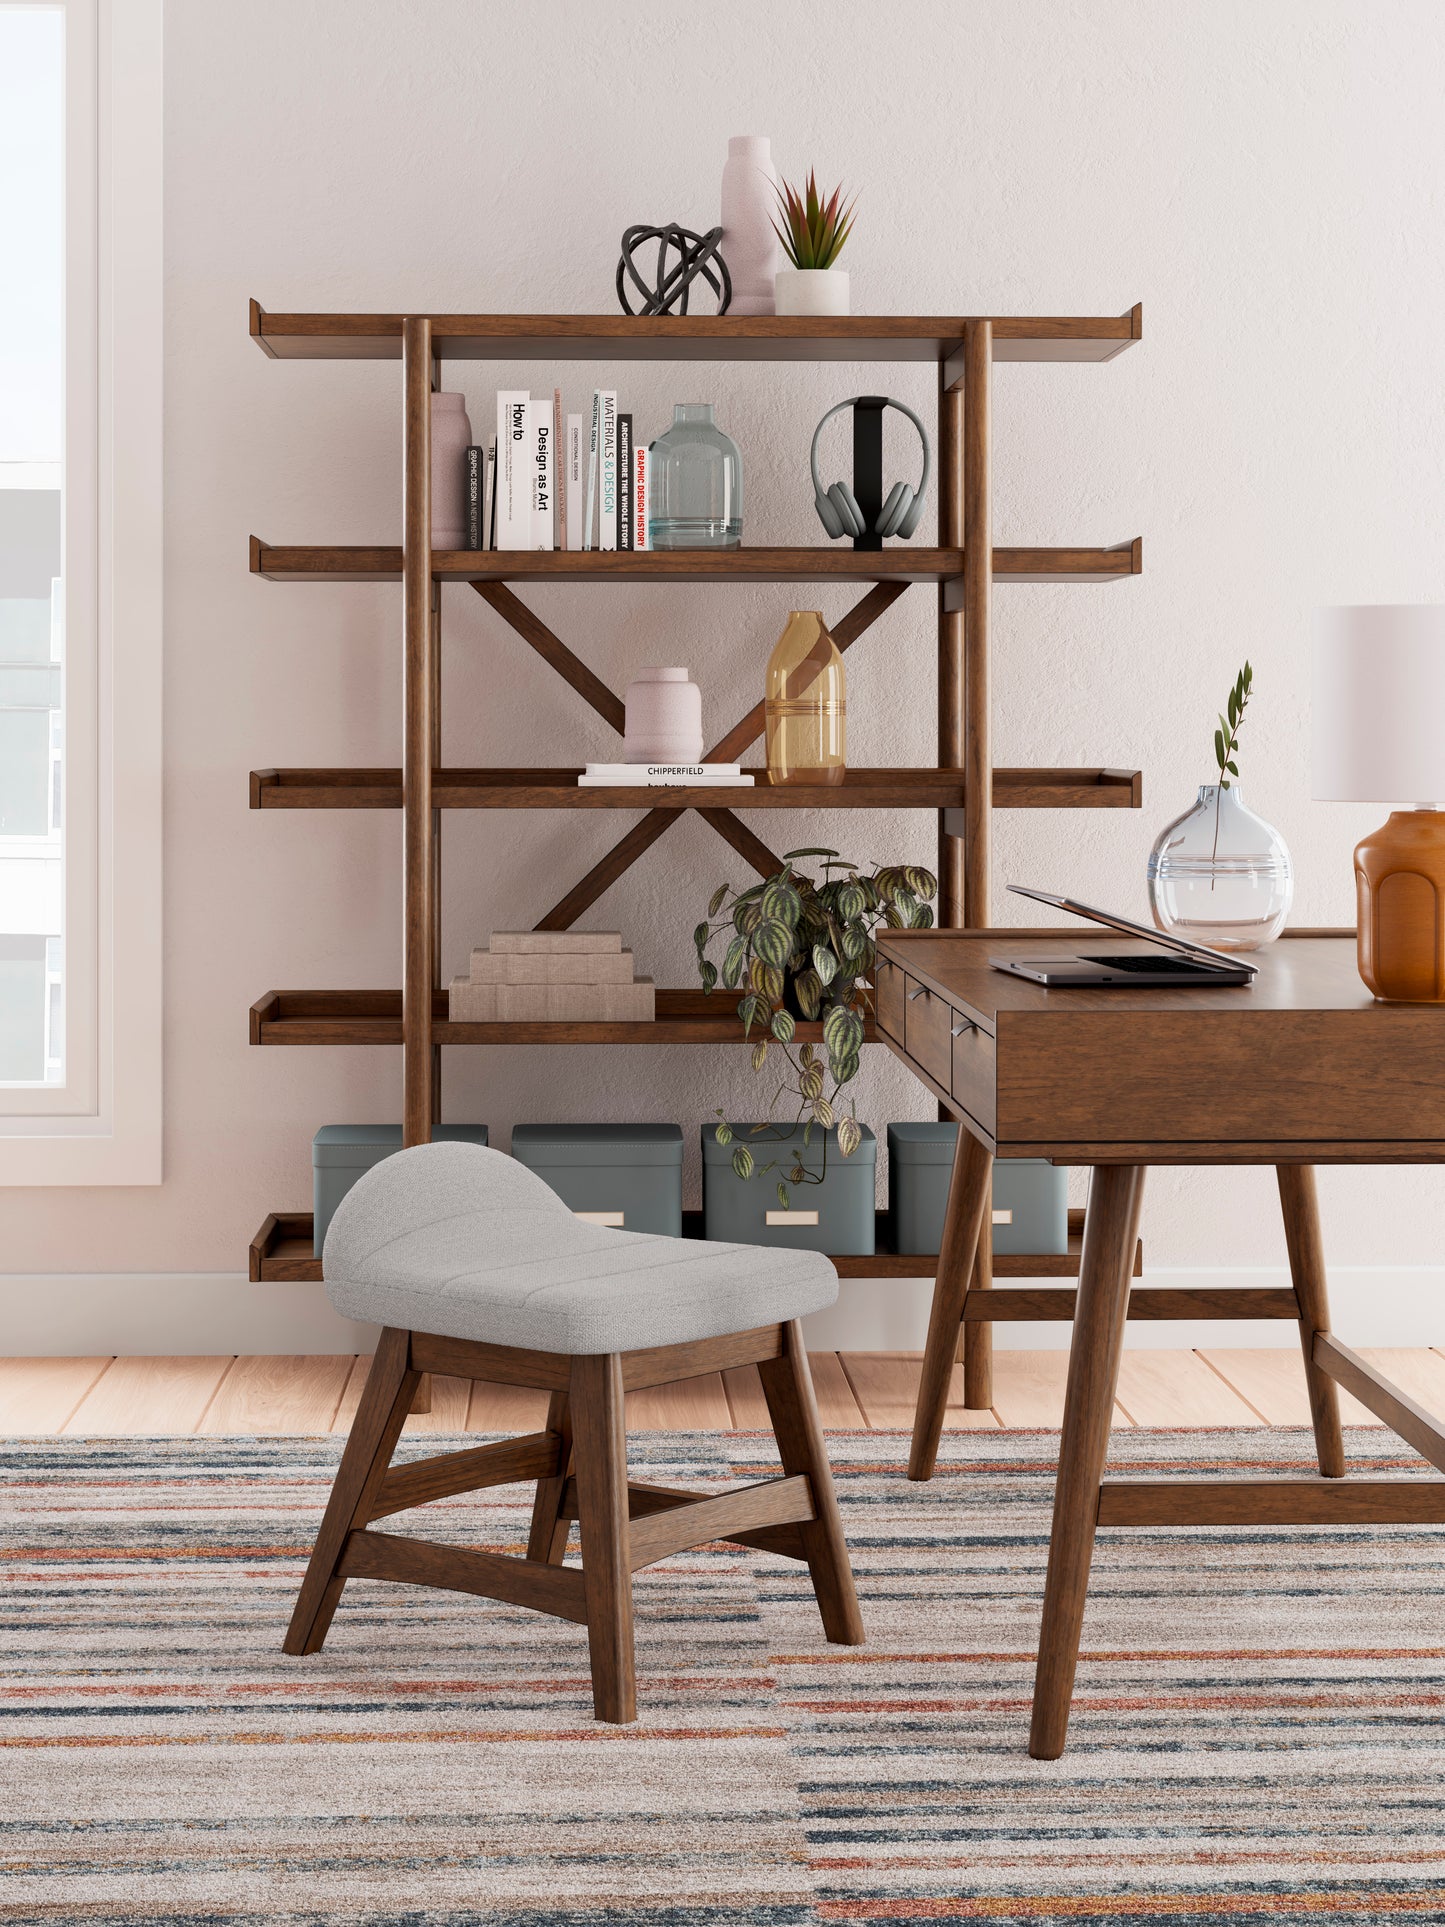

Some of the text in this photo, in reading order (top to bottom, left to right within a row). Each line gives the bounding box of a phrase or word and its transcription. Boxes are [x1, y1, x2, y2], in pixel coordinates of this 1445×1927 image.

[513, 404, 525, 441] How to
[604, 397, 614, 513] MATERIALS & DESIGN
[536, 428, 548, 511] Design as Art
[637, 450, 645, 547] GRAPHIC DESIGN HISTORY
[647, 767, 704, 775] CHIPPERFIELD
